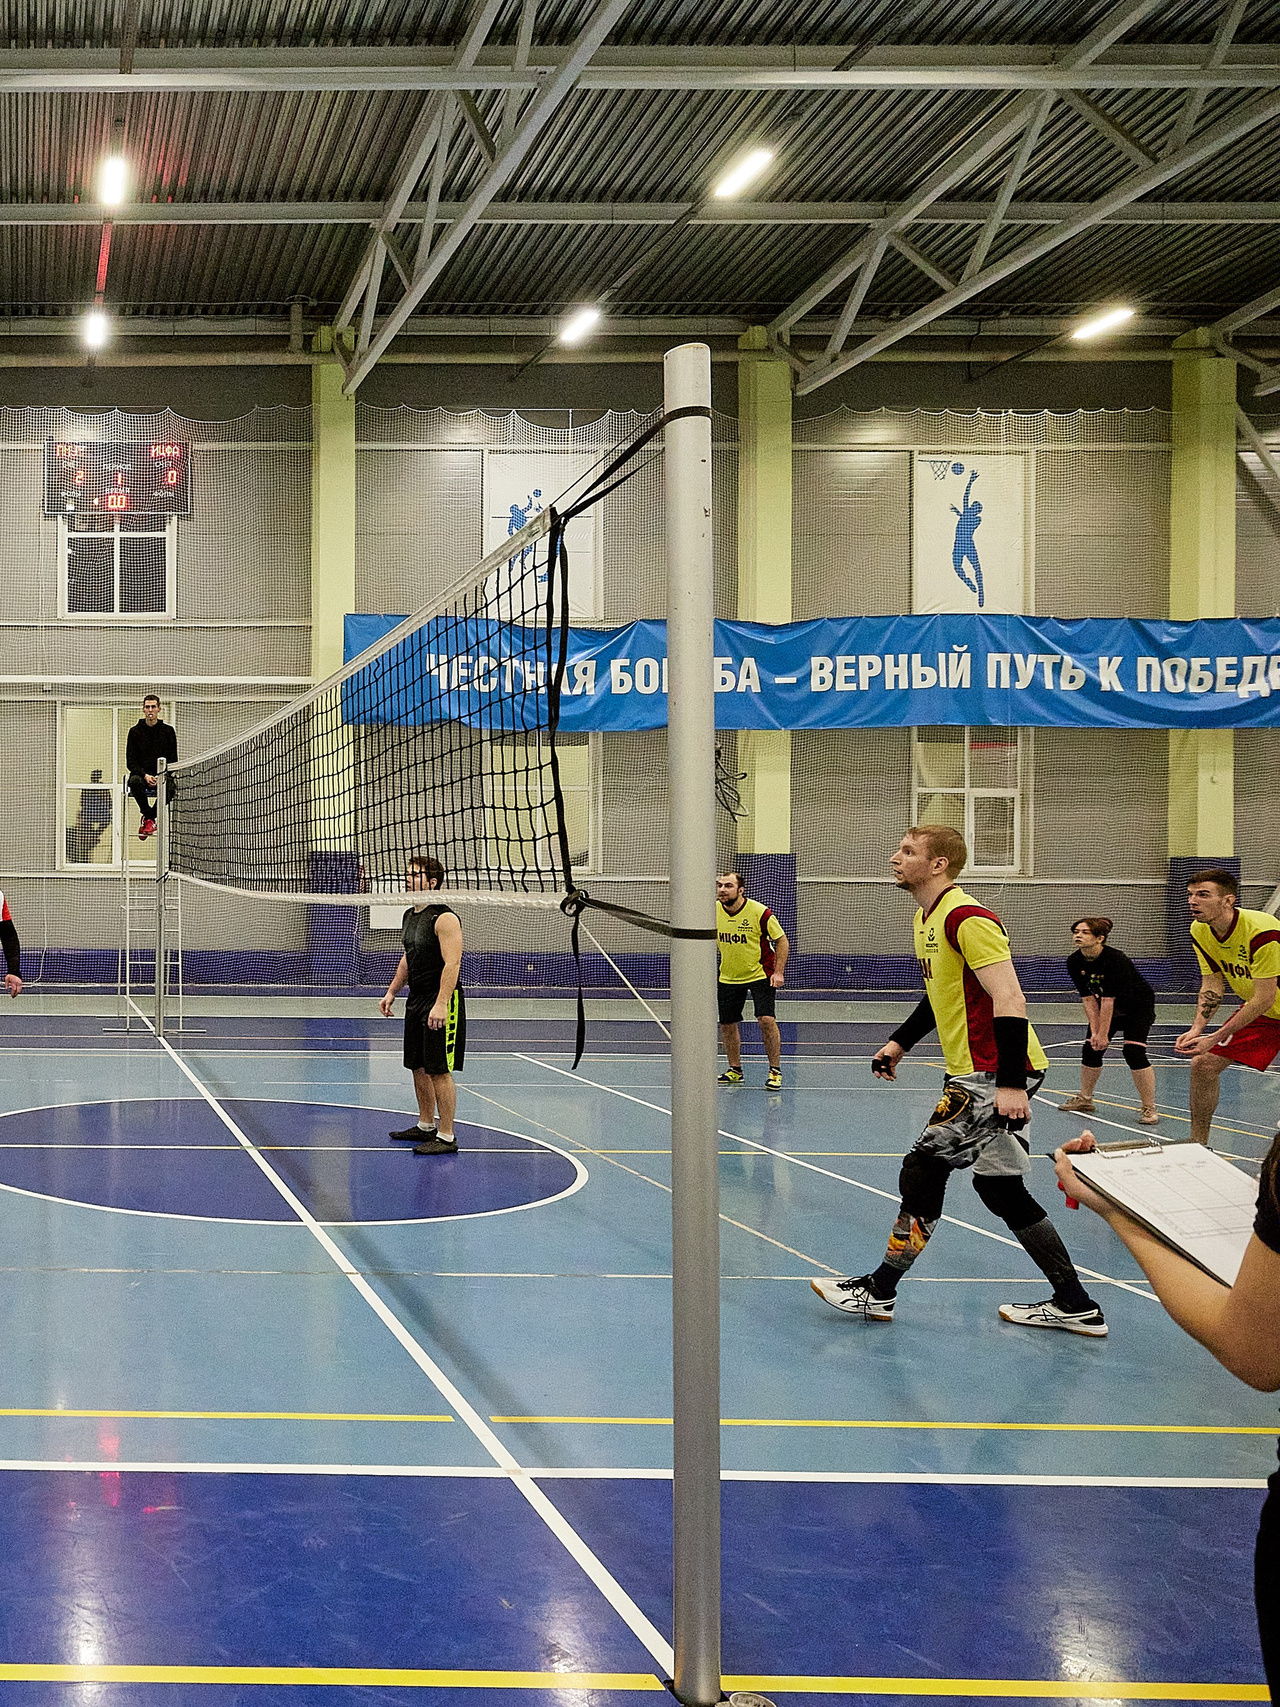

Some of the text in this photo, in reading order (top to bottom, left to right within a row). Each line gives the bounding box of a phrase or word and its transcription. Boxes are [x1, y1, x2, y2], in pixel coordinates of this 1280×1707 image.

[151, 444, 181, 457] ИЦФА
[75, 470, 84, 484] 2
[167, 470, 177, 484] 0
[610, 656, 762, 695] БОБА
[810, 644, 972, 693] ВЕРНЫЙ
[986, 653, 1087, 692] ПУТЬ
[1099, 655, 1125, 693] К
[719, 932, 748, 945] ИЦФА
